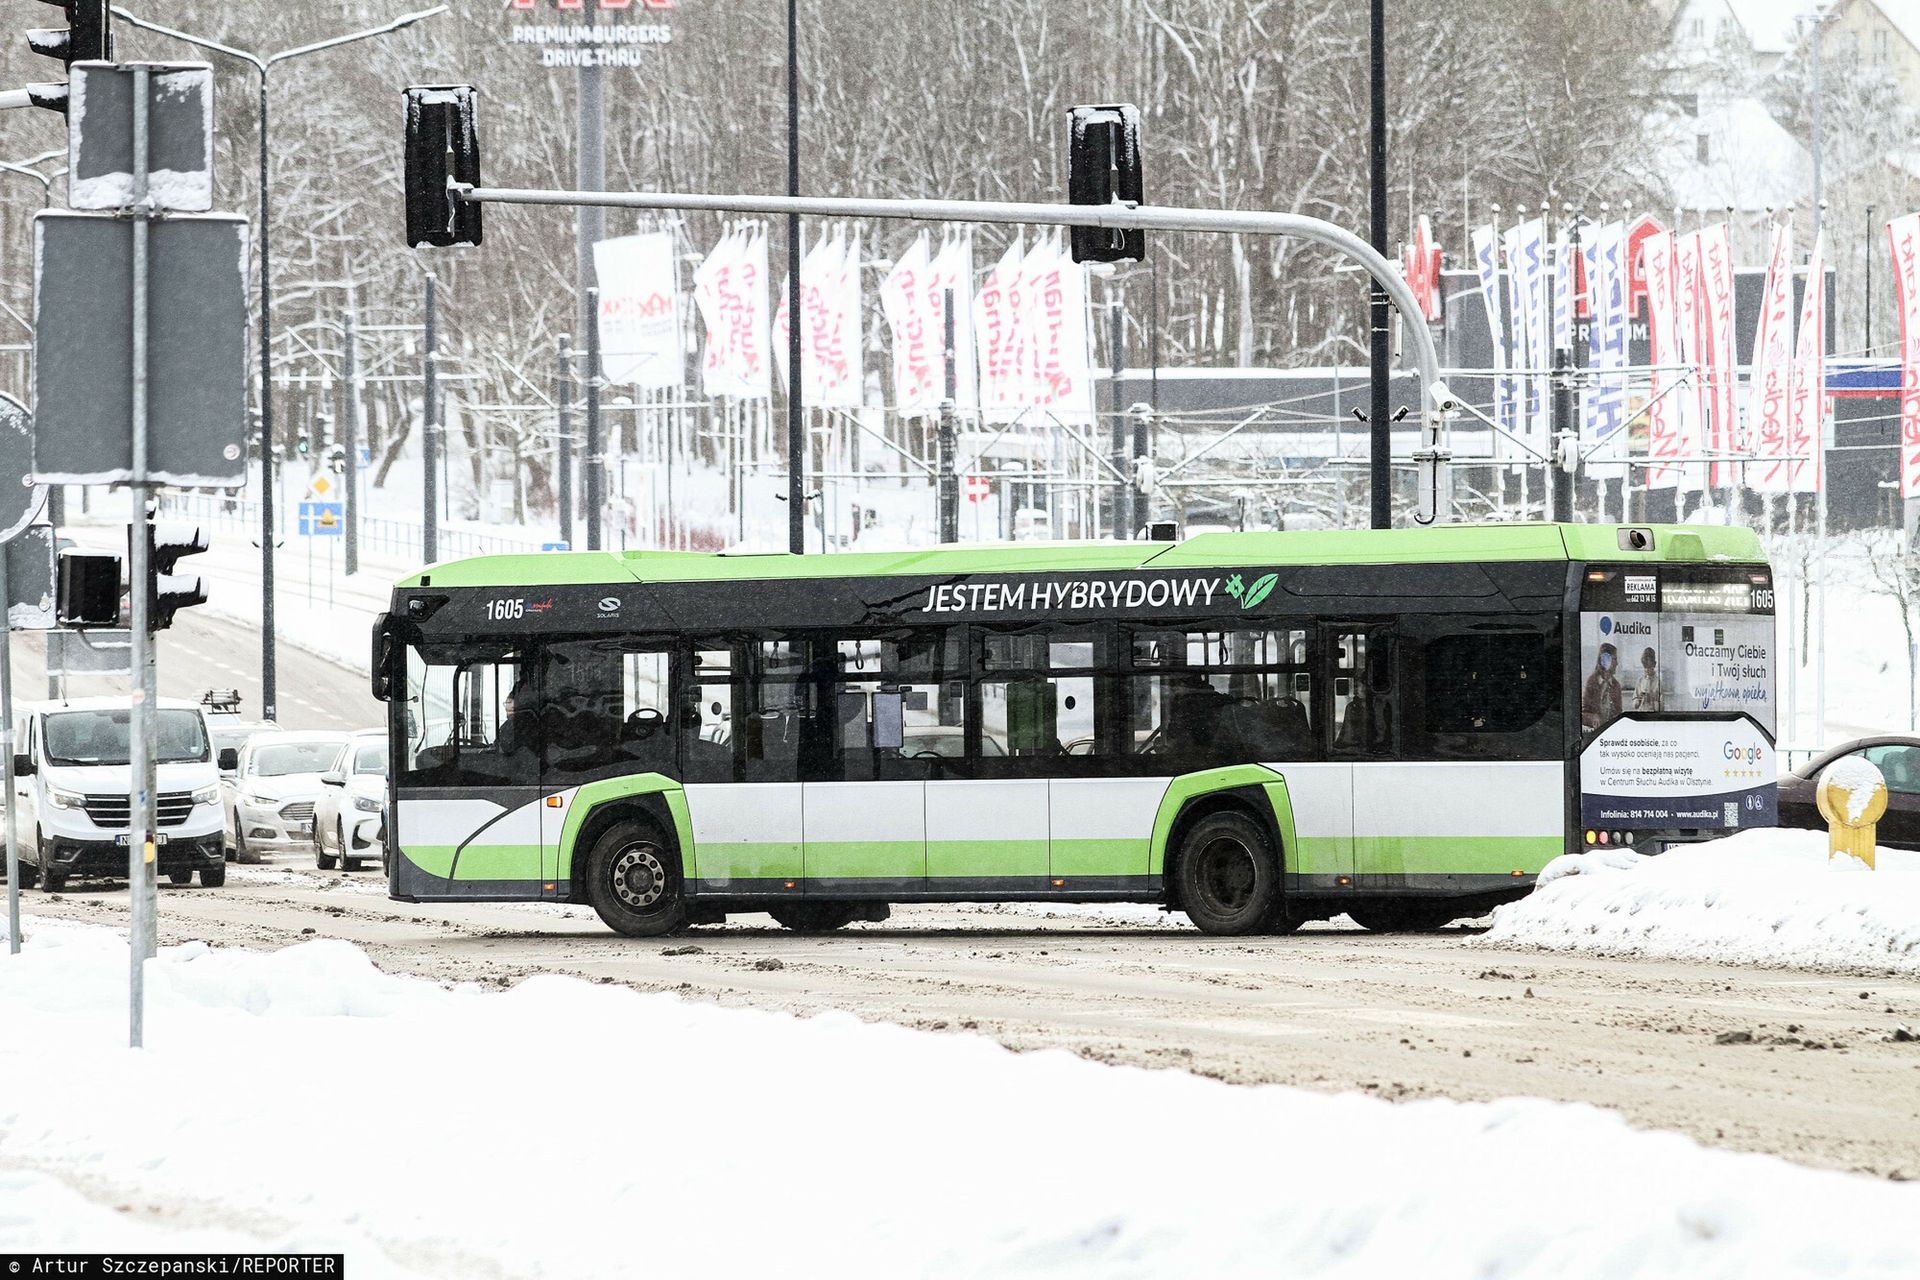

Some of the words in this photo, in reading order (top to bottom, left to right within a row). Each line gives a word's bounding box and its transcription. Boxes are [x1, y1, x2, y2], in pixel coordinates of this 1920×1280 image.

[512, 25, 590, 43] PREMIUM
[592, 24, 672, 43] BURGERS
[1626, 582, 1655, 592] REKLAMA
[922, 582, 1028, 613] JESTEM
[1030, 578, 1222, 610] HYBRYDOWY
[1751, 589, 1774, 609] 1605
[486, 599, 524, 620] 1605
[1613, 621, 1651, 635] Audika
[1685, 642, 1735, 661] Otaczamy
[1737, 644, 1767, 659] Ciebie
[1711, 662, 1715, 676] i
[1717, 663, 1740, 680] Twój
[1742, 664, 1766, 678] słuch
[1599, 738, 1628, 748] Sprawdź
[1599, 750, 1610, 758] tak
[1611, 750, 1636, 760] wysoko
[1724, 741, 1762, 765] Google
[1641, 766, 1673, 777] bezpłatną
[1674, 766, 1694, 777] wizytę
[1607, 777, 1635, 786] Centrum
[1636, 777, 1657, 786] Słuchu
[1658, 777, 1679, 786] Audika
[1600, 810, 1630, 819] Infolinia:
[1630, 809, 1643, 819] 814
[1643, 809, 1655, 819] 714
[1655, 809, 1668, 819] 004
[1676, 810, 1719, 820] www.audika.pl
